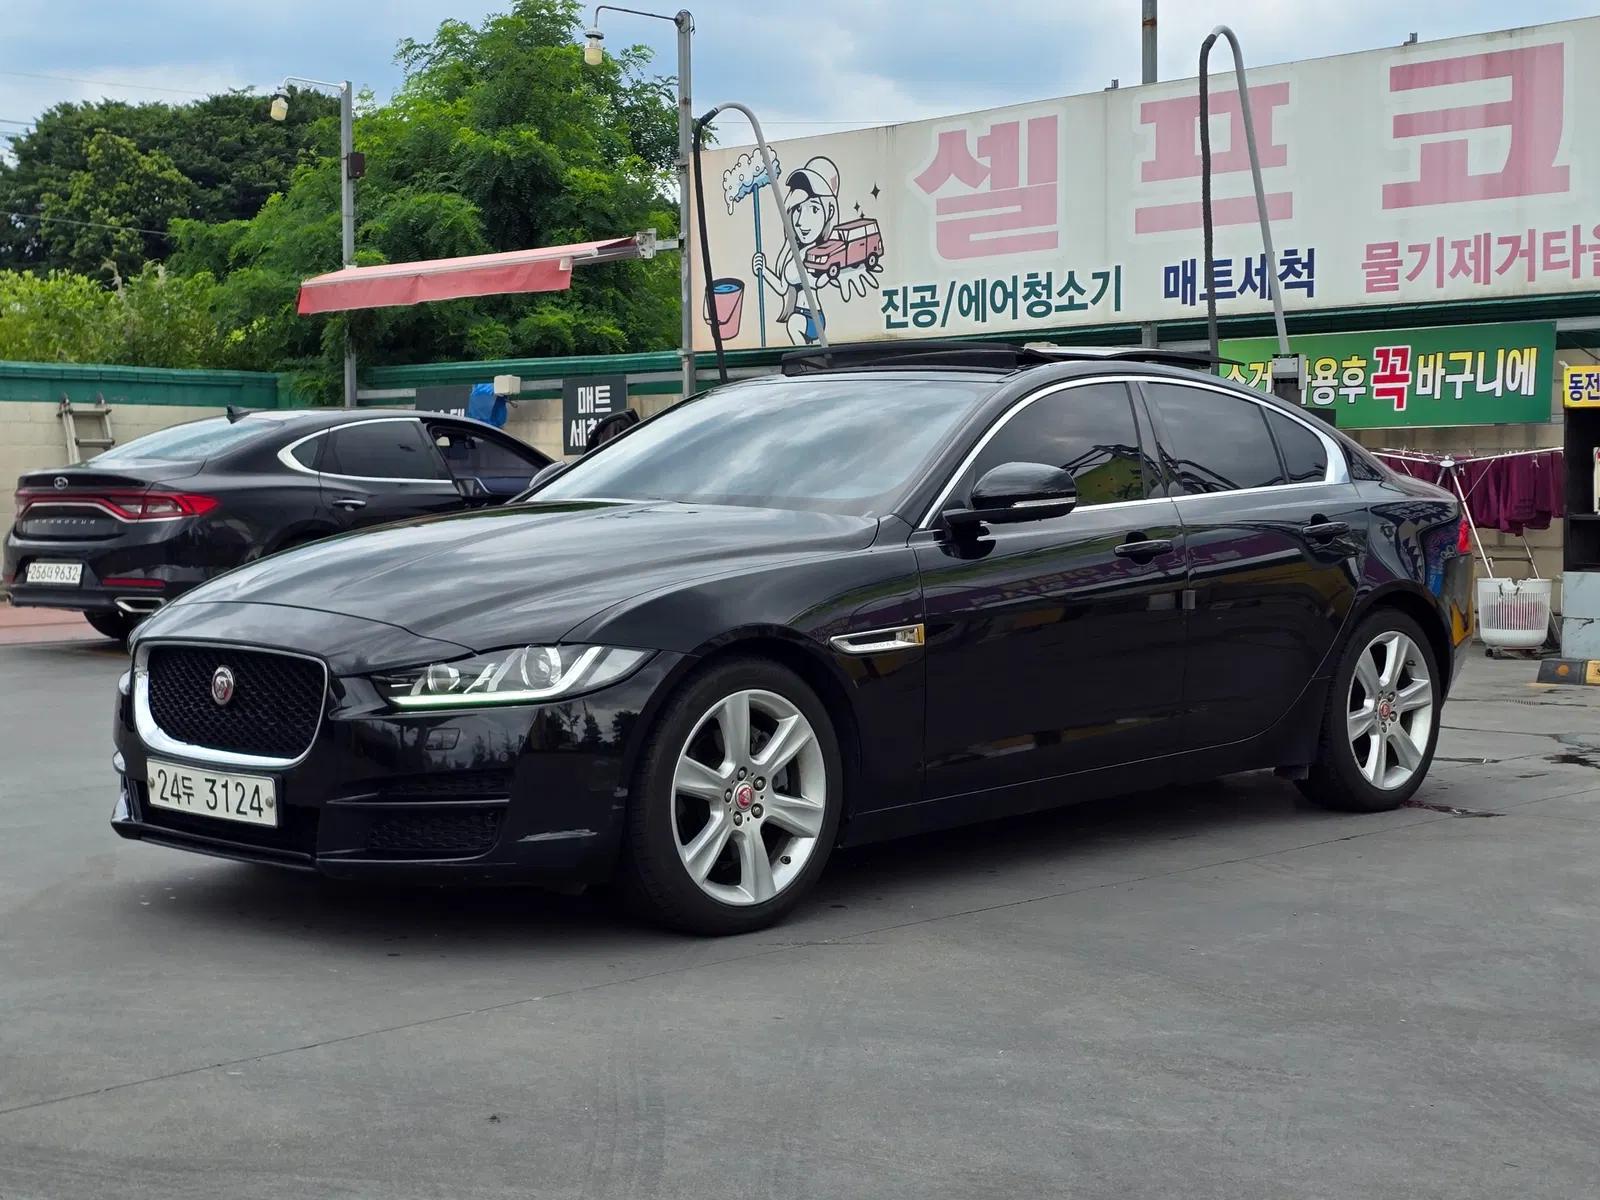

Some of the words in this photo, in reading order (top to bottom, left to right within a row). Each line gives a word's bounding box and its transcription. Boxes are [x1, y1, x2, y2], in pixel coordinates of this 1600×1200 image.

[881, 265, 1121, 329] 진공/에어청소기
[1163, 247, 1316, 307] 매트세척
[577, 385, 612, 414] 매트
[1371, 345, 1412, 411] 꼭
[1415, 347, 1538, 400] 바구니에
[1568, 372, 1600, 402] 동전
[157, 768, 195, 806] 24두
[204, 777, 264, 818] 3124
